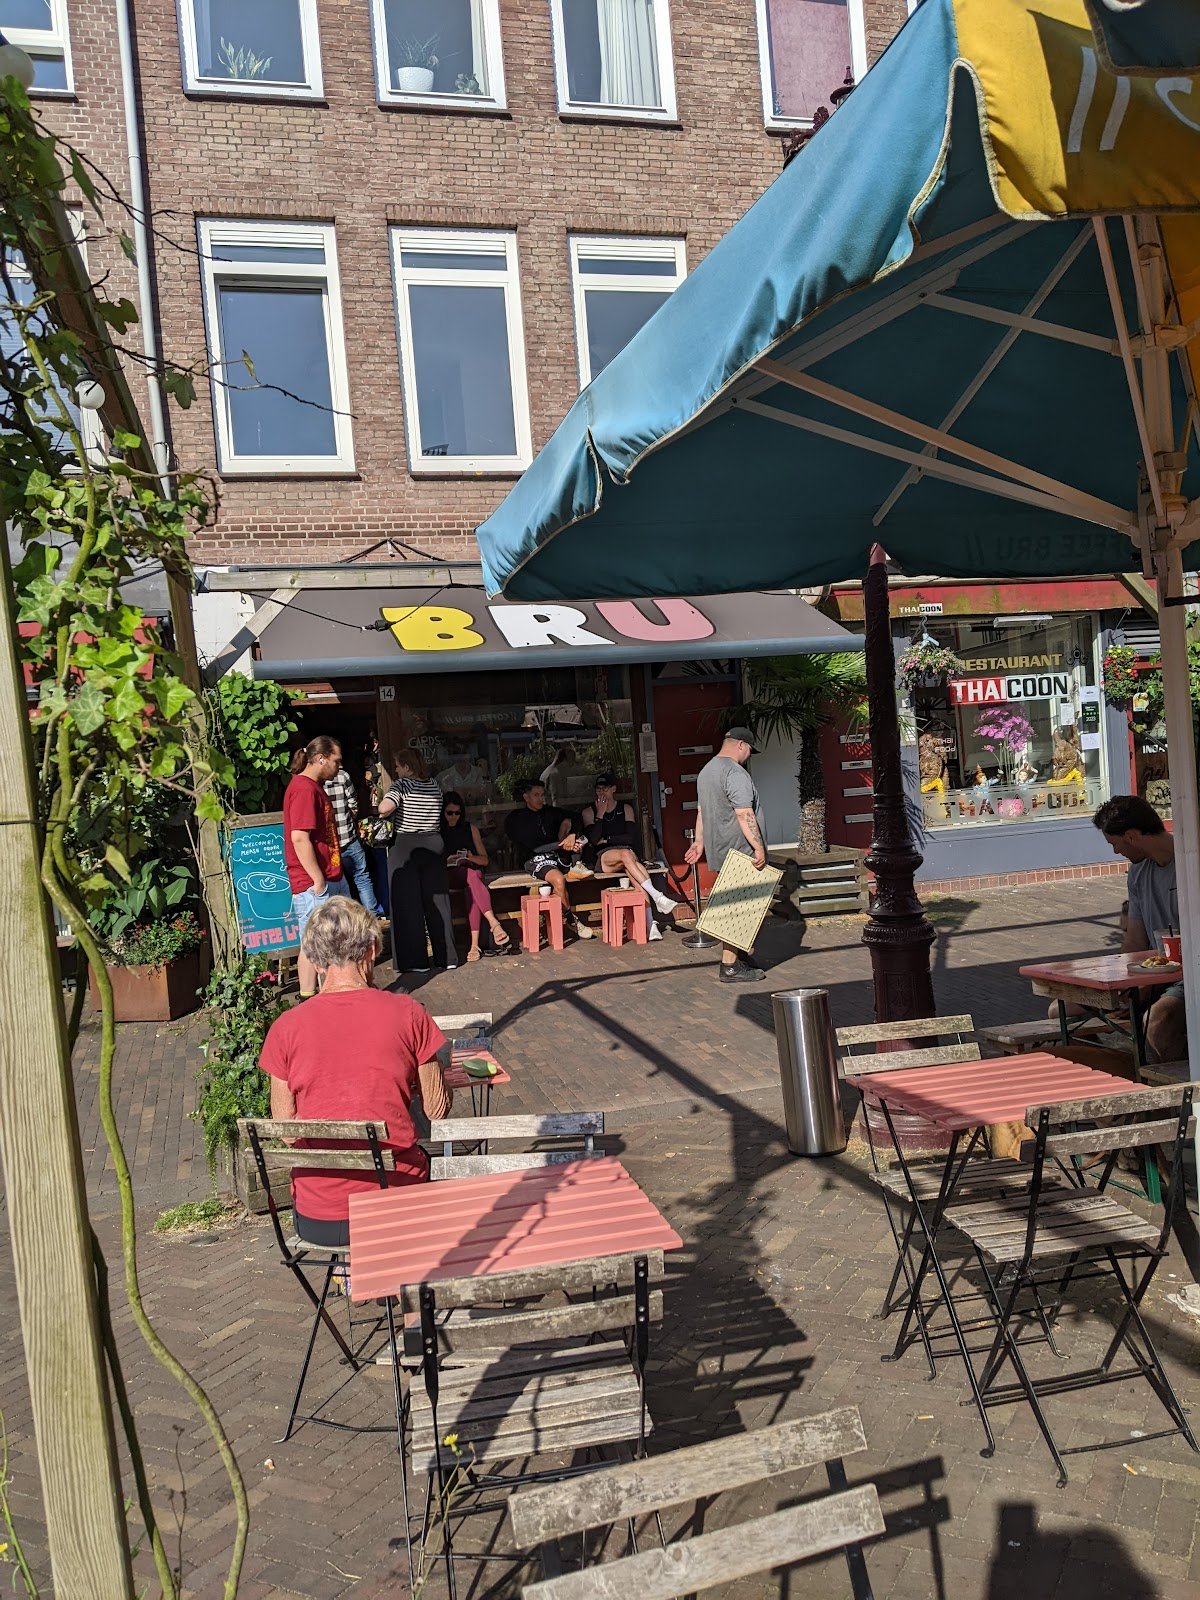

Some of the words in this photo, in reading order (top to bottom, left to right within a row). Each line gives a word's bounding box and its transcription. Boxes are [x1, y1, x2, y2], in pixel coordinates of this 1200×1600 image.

[381, 598, 716, 651] BRU
[381, 687, 394, 700] 14
[241, 927, 283, 949] COFFEE
